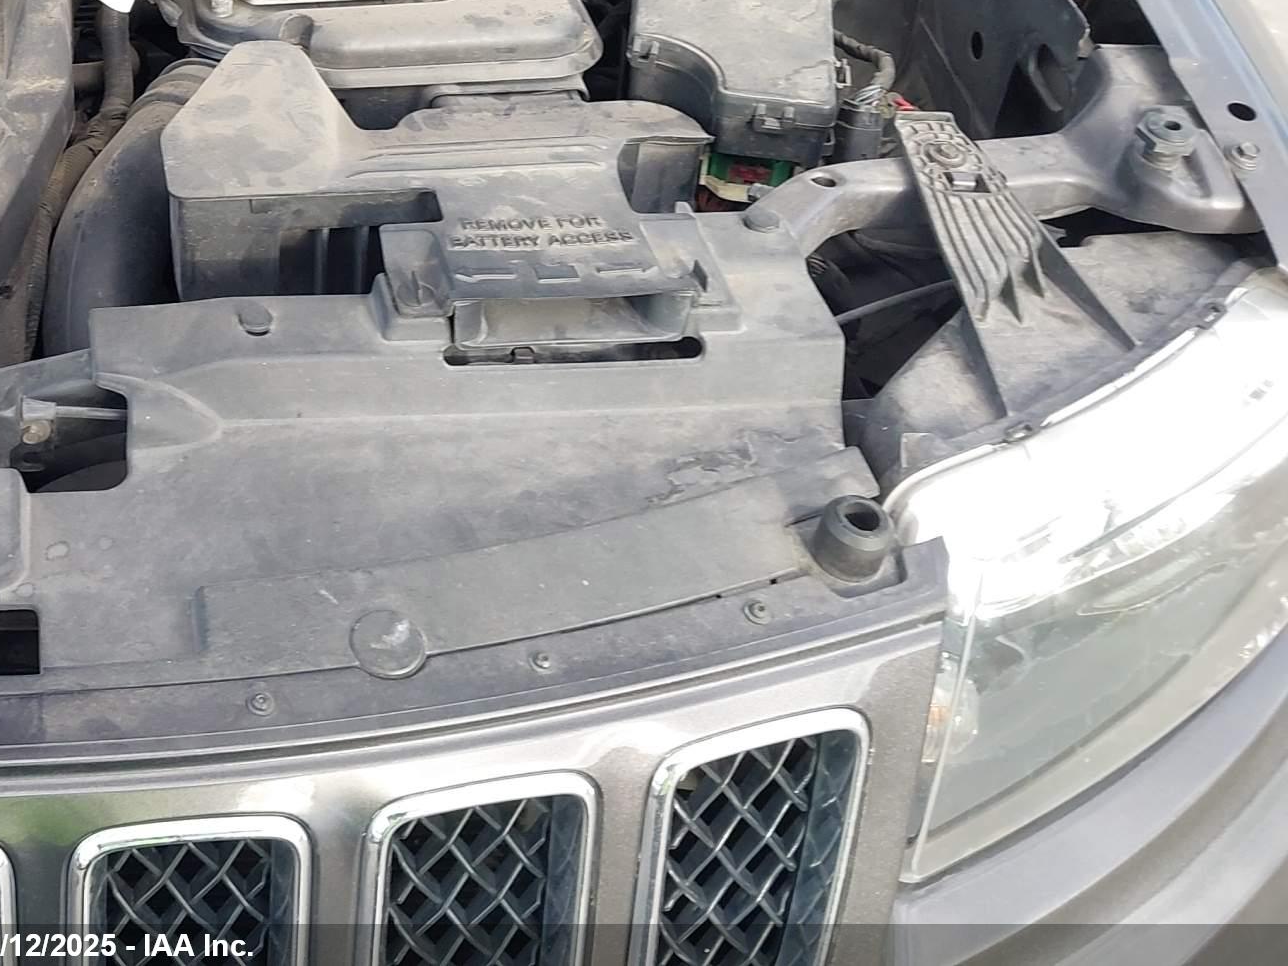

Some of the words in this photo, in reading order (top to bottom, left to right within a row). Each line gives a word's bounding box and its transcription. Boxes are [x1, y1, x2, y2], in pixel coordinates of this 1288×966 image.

[460, 216, 550, 232] REMOVE
[557, 212, 602, 229] FOR
[448, 233, 541, 249] BATTERY
[548, 231, 635, 246] ACCESS
